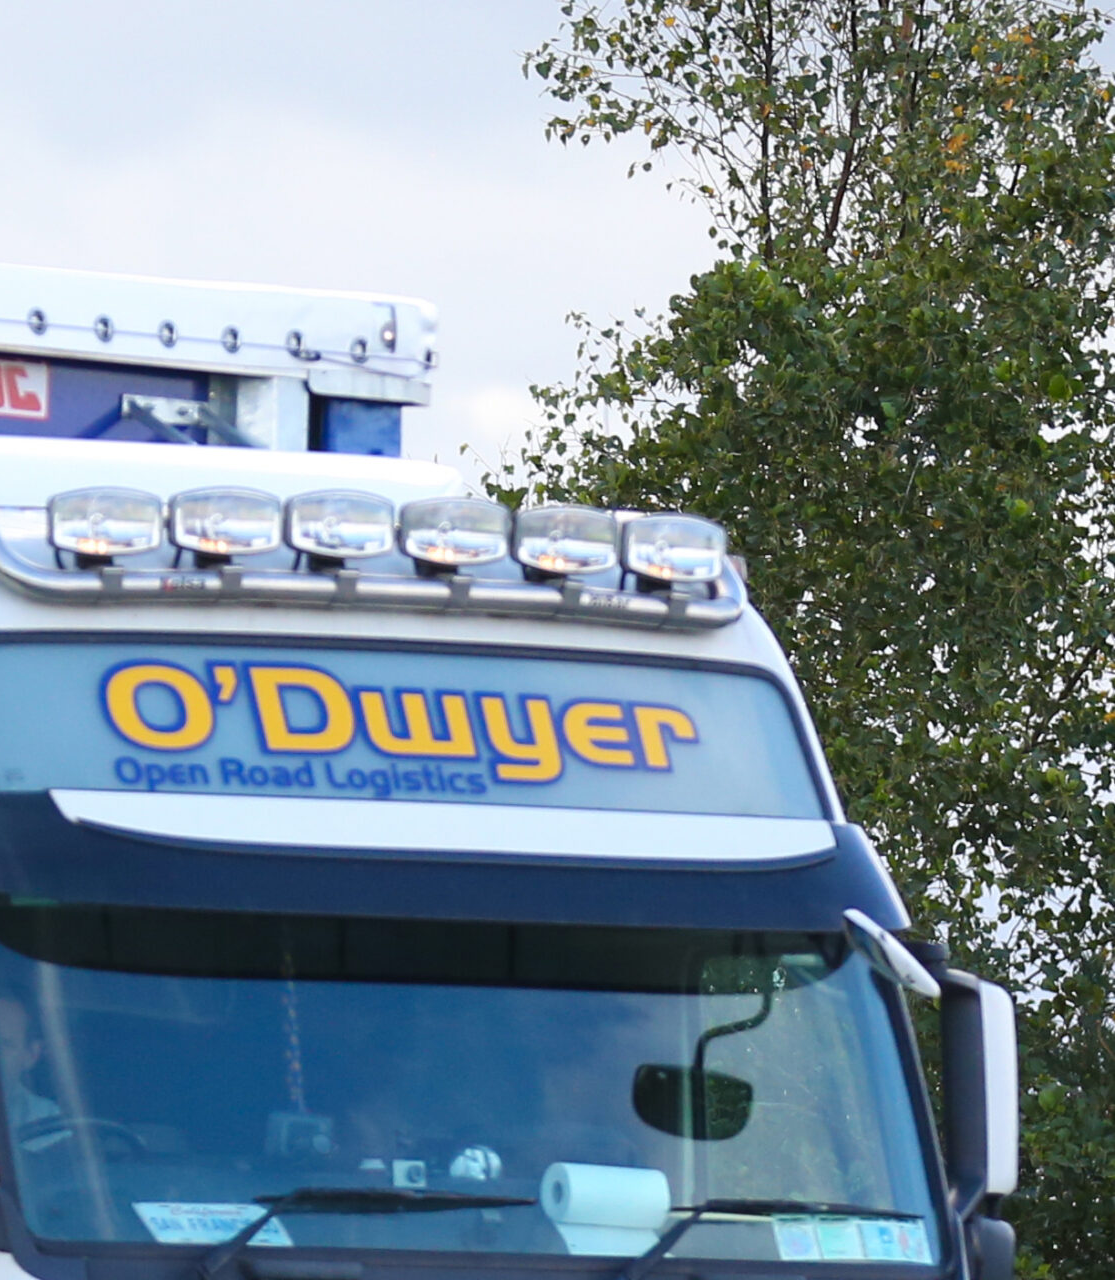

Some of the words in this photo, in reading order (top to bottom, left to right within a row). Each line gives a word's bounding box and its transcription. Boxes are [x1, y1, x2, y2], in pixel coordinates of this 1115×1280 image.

[101, 659, 699, 786] O'Dwyer
[114, 756, 209, 791] Open
[218, 758, 315, 788] Road
[325, 760, 487, 797] Logistics
